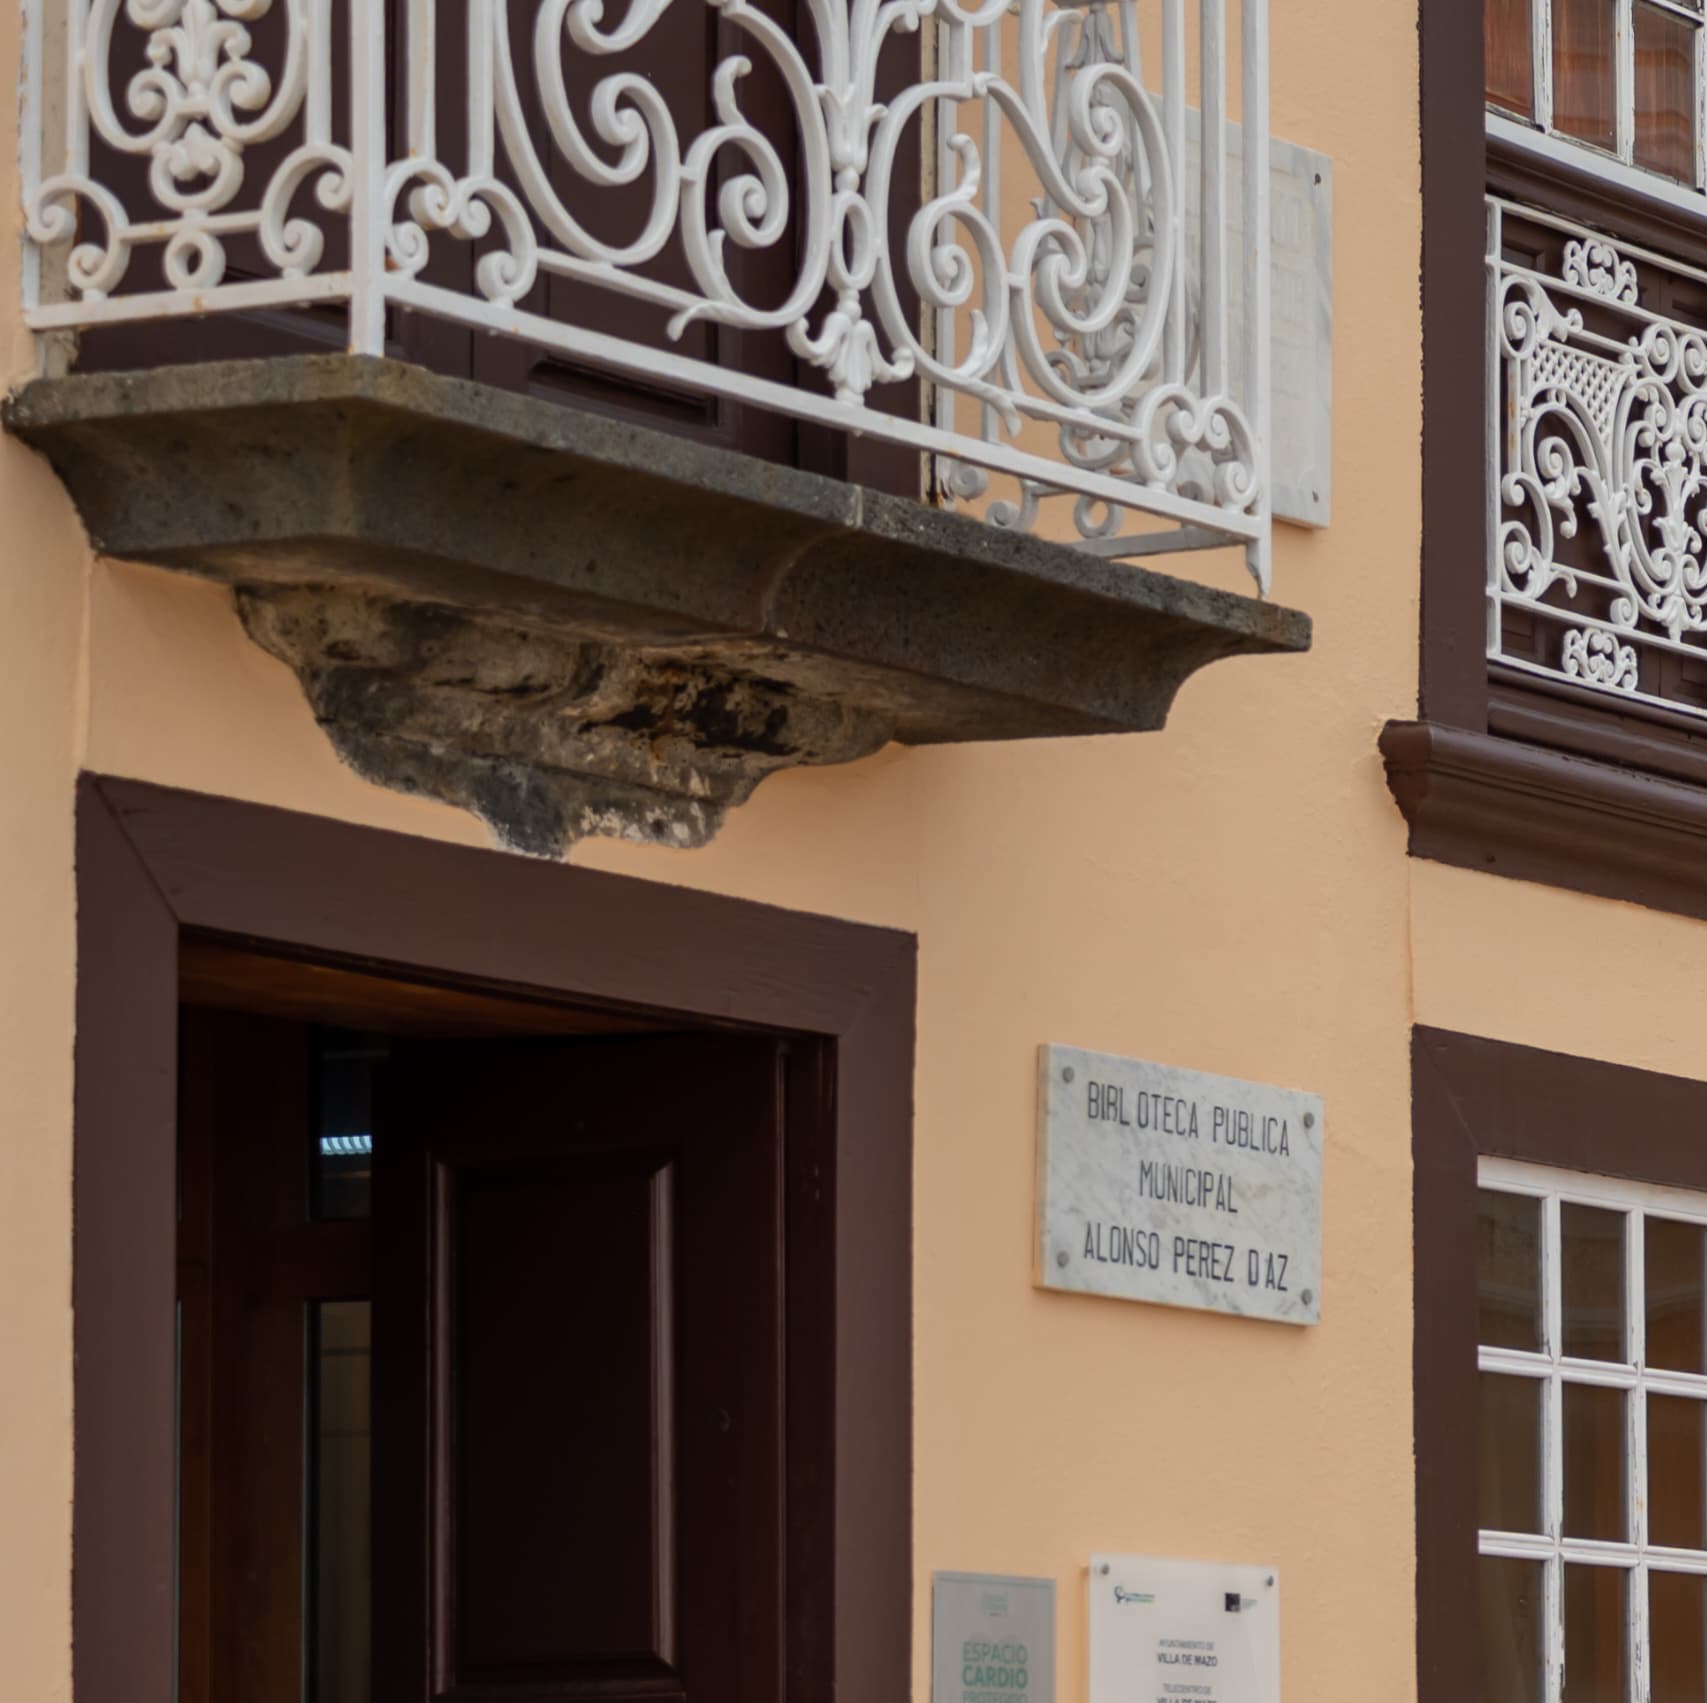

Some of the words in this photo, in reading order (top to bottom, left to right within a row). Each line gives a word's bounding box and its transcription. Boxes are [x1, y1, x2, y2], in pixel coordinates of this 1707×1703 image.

[1212, 1105, 1290, 1157] PUBLICA
[1139, 1159, 1239, 1214] MUNICIPAL
[1083, 1221, 1160, 1271] ALONSO
[1173, 1236, 1235, 1283] PEREZ
[1247, 1249, 1289, 1292] DAZ
[962, 1641, 1028, 1665] ESPACIO
[1156, 1653, 1180, 1665] VILLA
[1182, 1654, 1193, 1666] DE
[1194, 1655, 1218, 1668] MAZO
